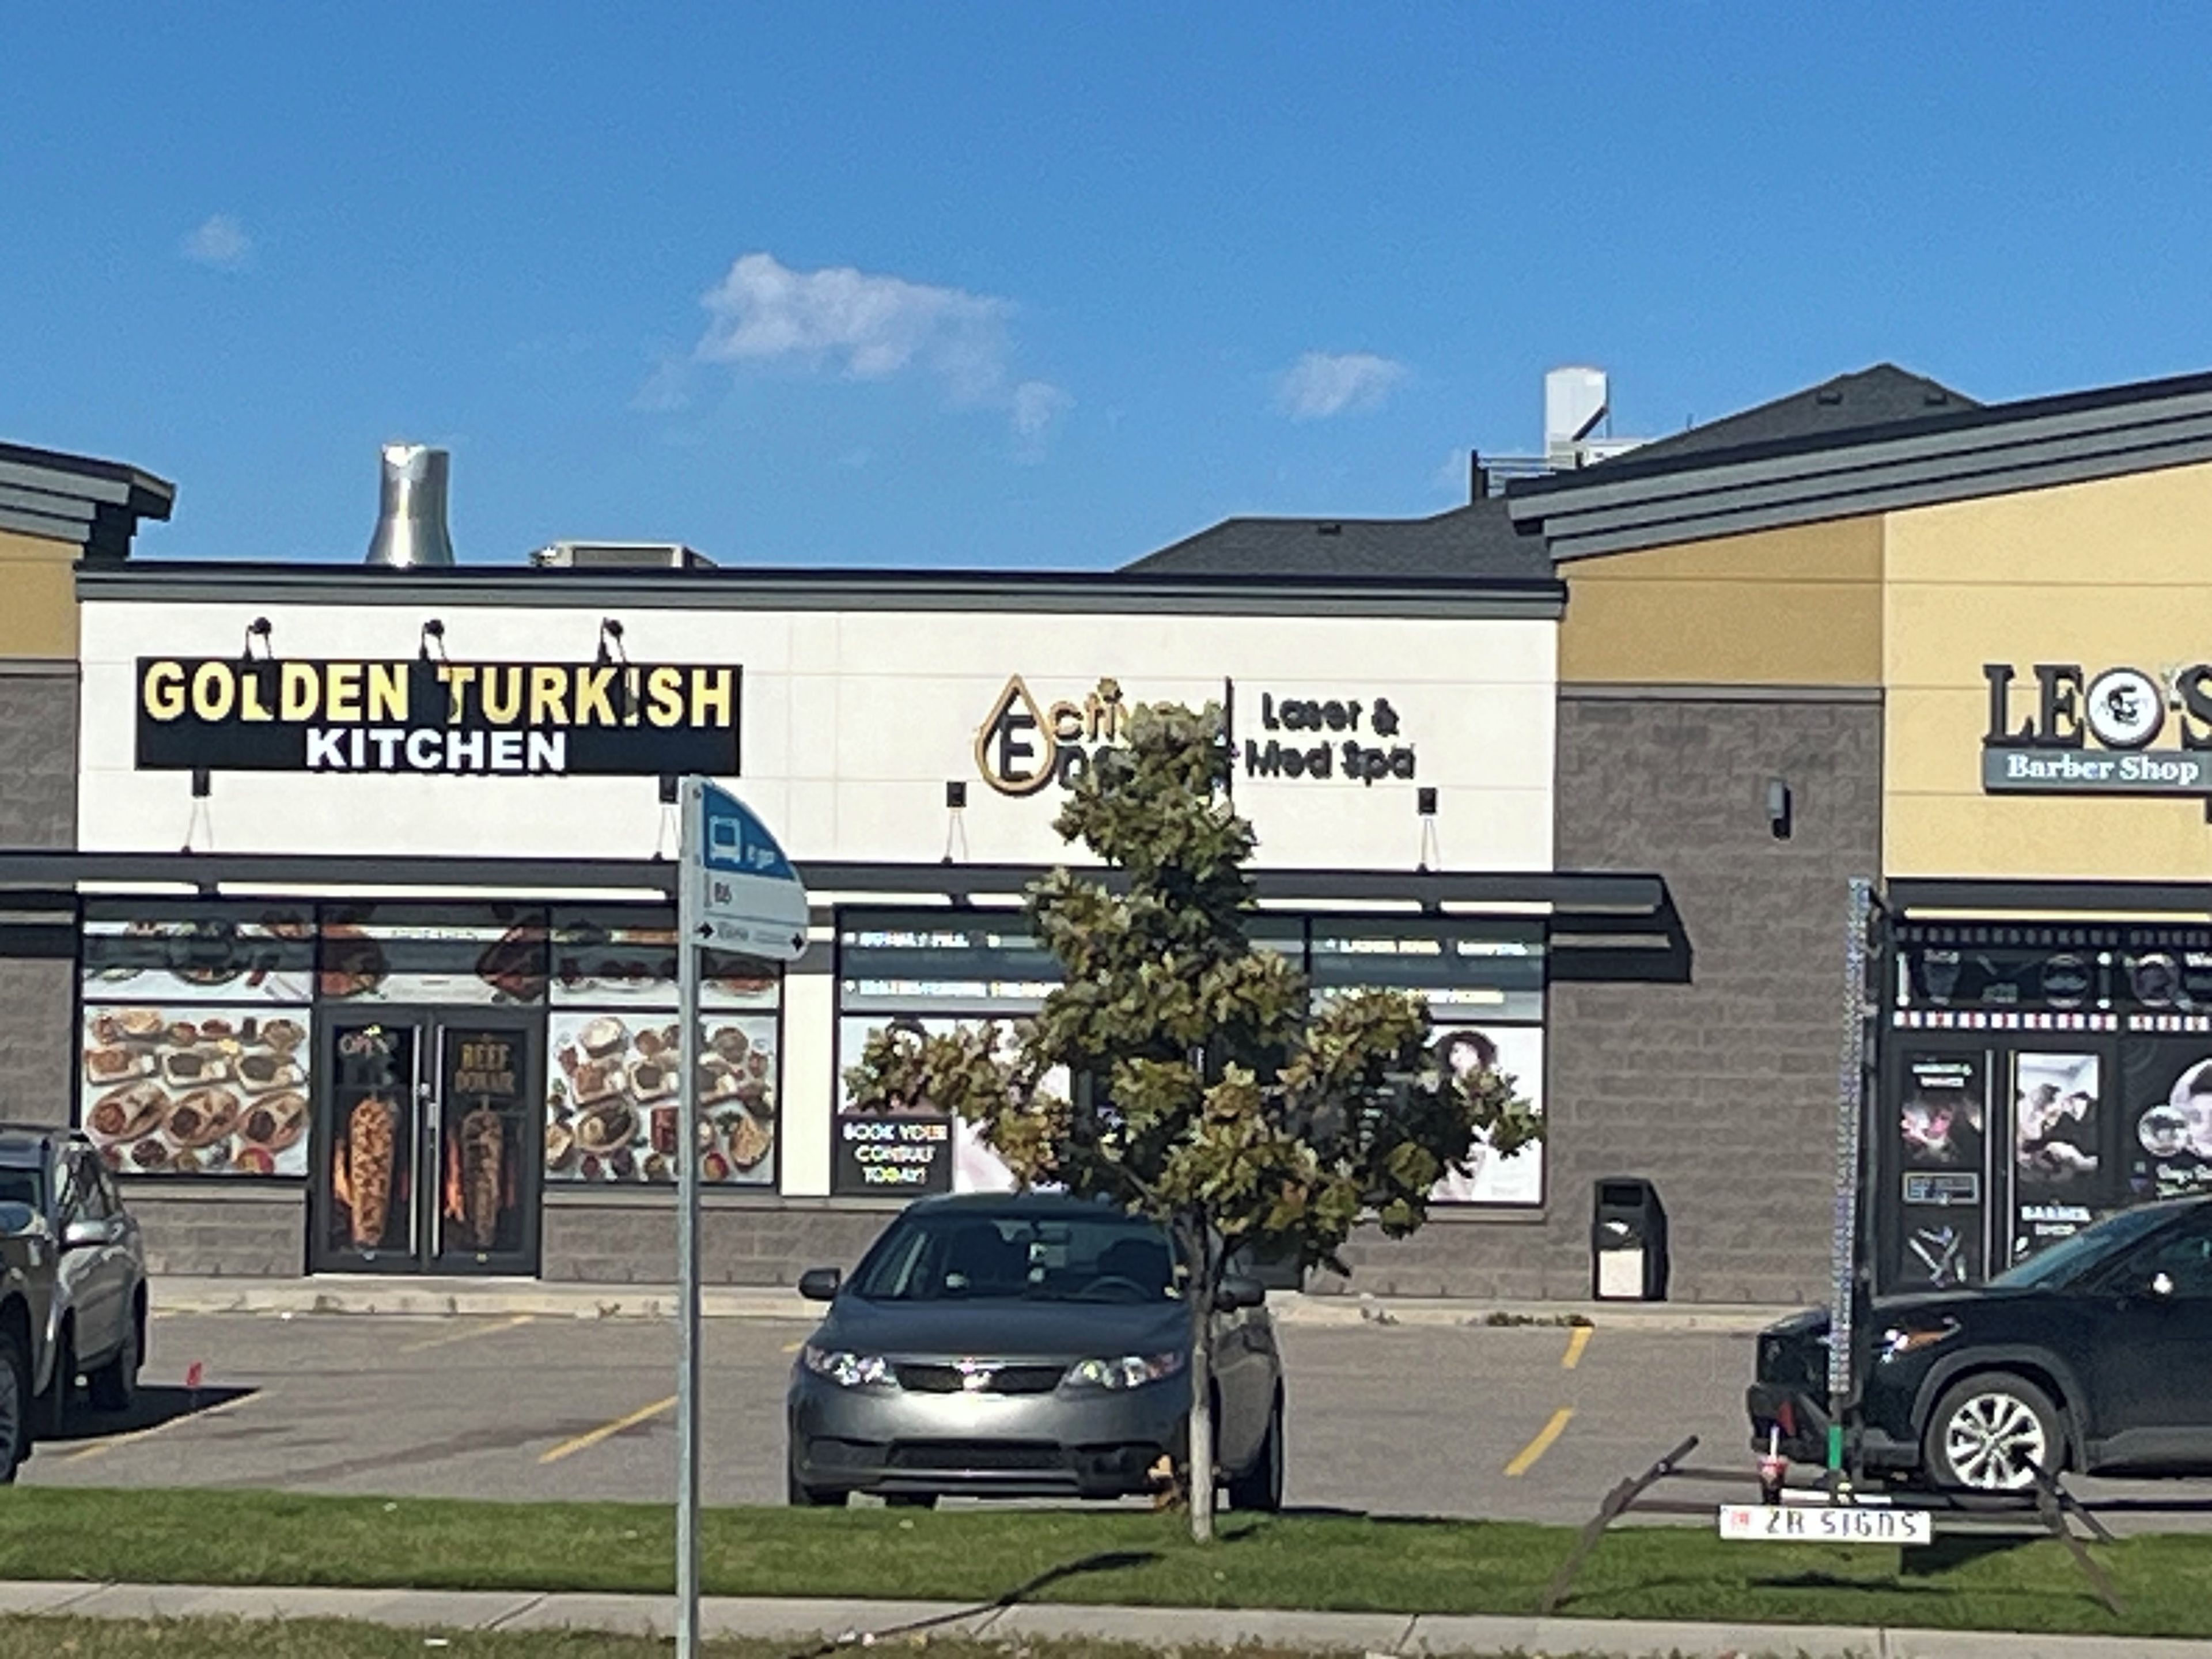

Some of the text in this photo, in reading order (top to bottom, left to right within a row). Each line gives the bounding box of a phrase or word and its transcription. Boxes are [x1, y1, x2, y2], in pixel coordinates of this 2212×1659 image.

[143, 660, 732, 728] GOLDEN TURKISH
[1262, 692, 1400, 738] Laser &
[306, 727, 566, 771] KITCHEN
[1245, 740, 1333, 779] Med
[2006, 753, 2199, 786] Barber Shop
